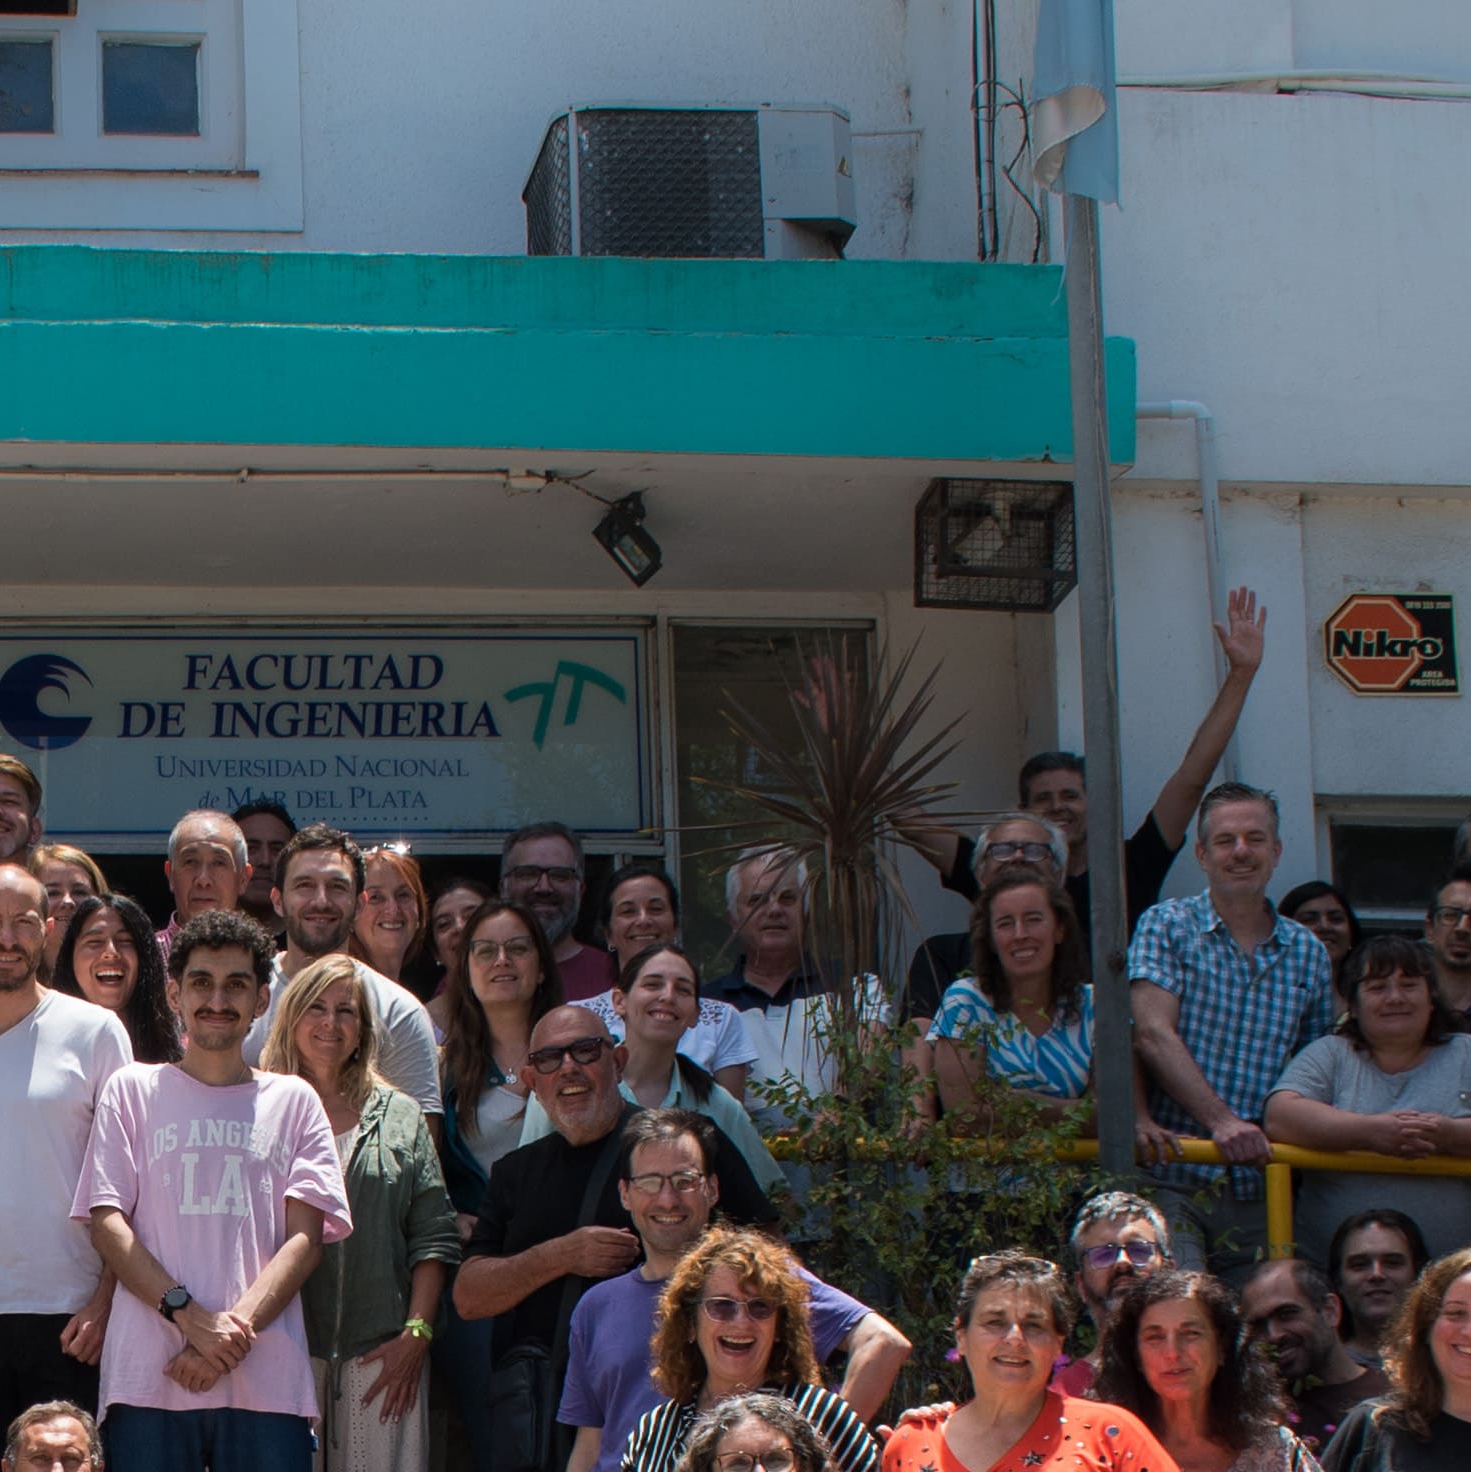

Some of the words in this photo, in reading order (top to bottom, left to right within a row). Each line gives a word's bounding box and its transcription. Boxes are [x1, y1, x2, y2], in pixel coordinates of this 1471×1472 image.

[1330, 628, 1443, 658] Nikro
[183, 653, 444, 690] FACULTAD
[117, 701, 186, 738] DE
[209, 700, 502, 738] INGENIERIA
[154, 755, 327, 779] UNIVERSIDAD
[334, 755, 470, 778] NACIONAL
[197, 790, 220, 809] de
[297, 789, 344, 809] DEL
[347, 786, 429, 809] PLATA
[178, 1153, 251, 1217] LA
